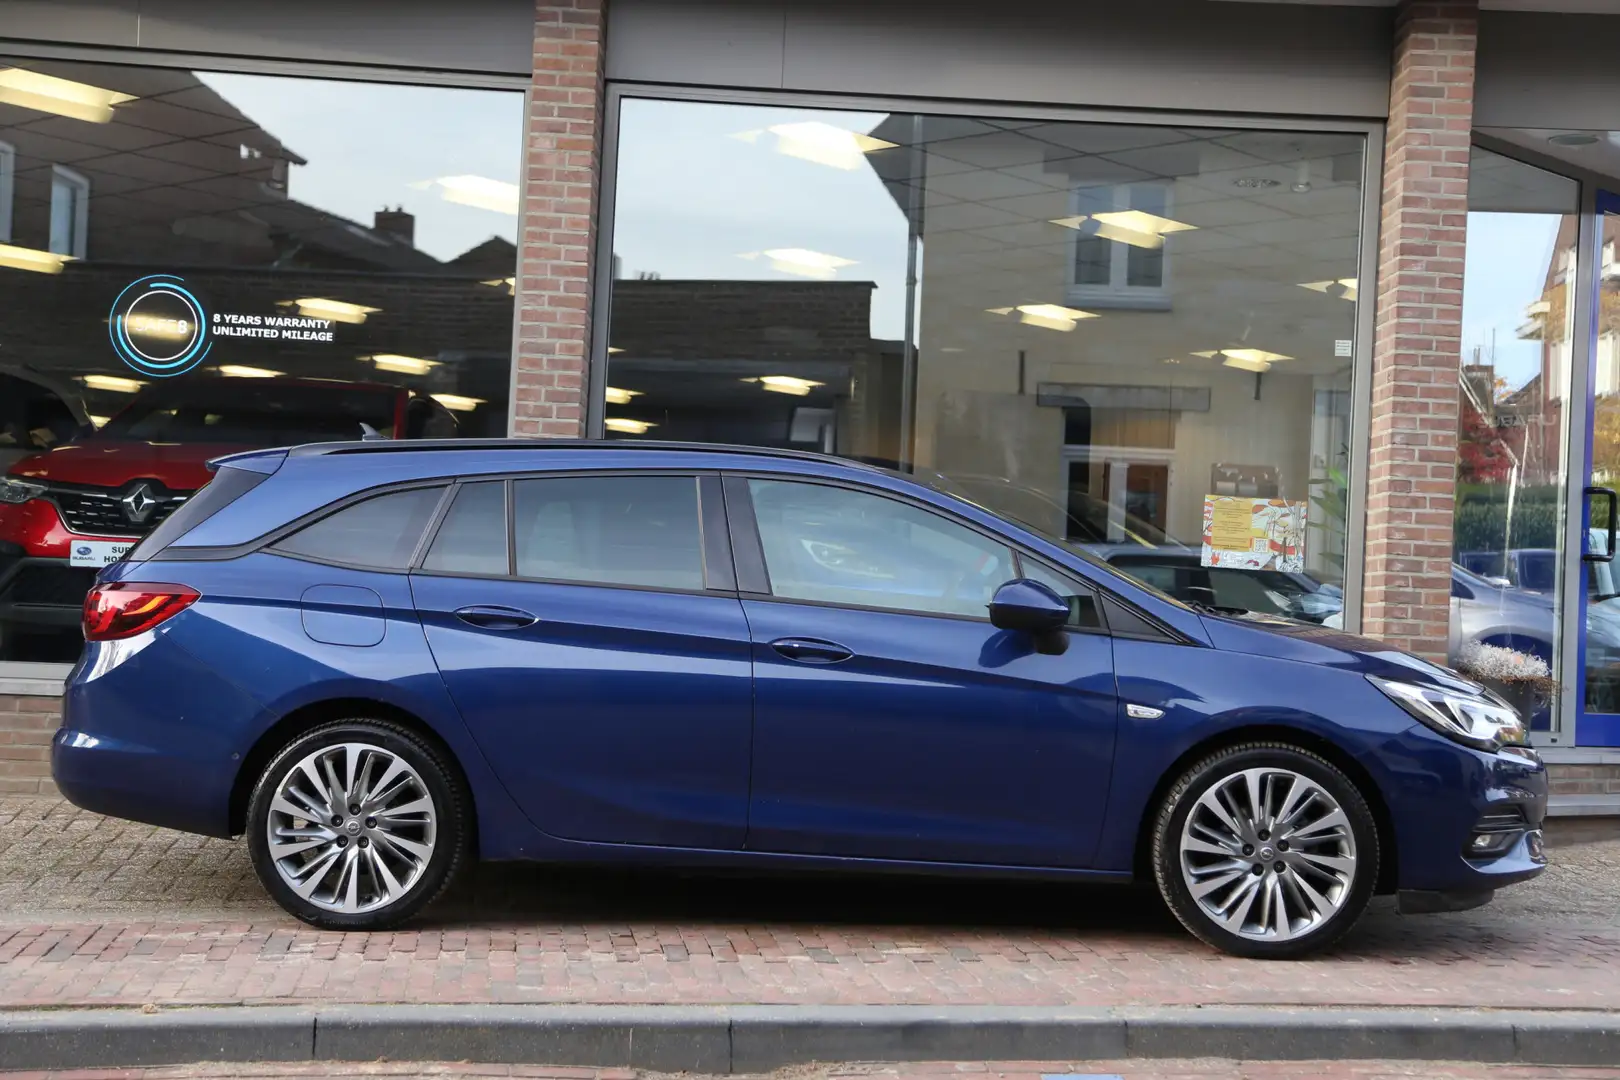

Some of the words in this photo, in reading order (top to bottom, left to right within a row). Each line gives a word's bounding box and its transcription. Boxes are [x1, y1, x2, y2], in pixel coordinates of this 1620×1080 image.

[212, 313, 221, 323] 8
[223, 314, 262, 326] YEARS
[264, 316, 331, 329] WARRANTY
[212, 325, 279, 339] UNLIMITED
[281, 330, 334, 342] MILEAGE
